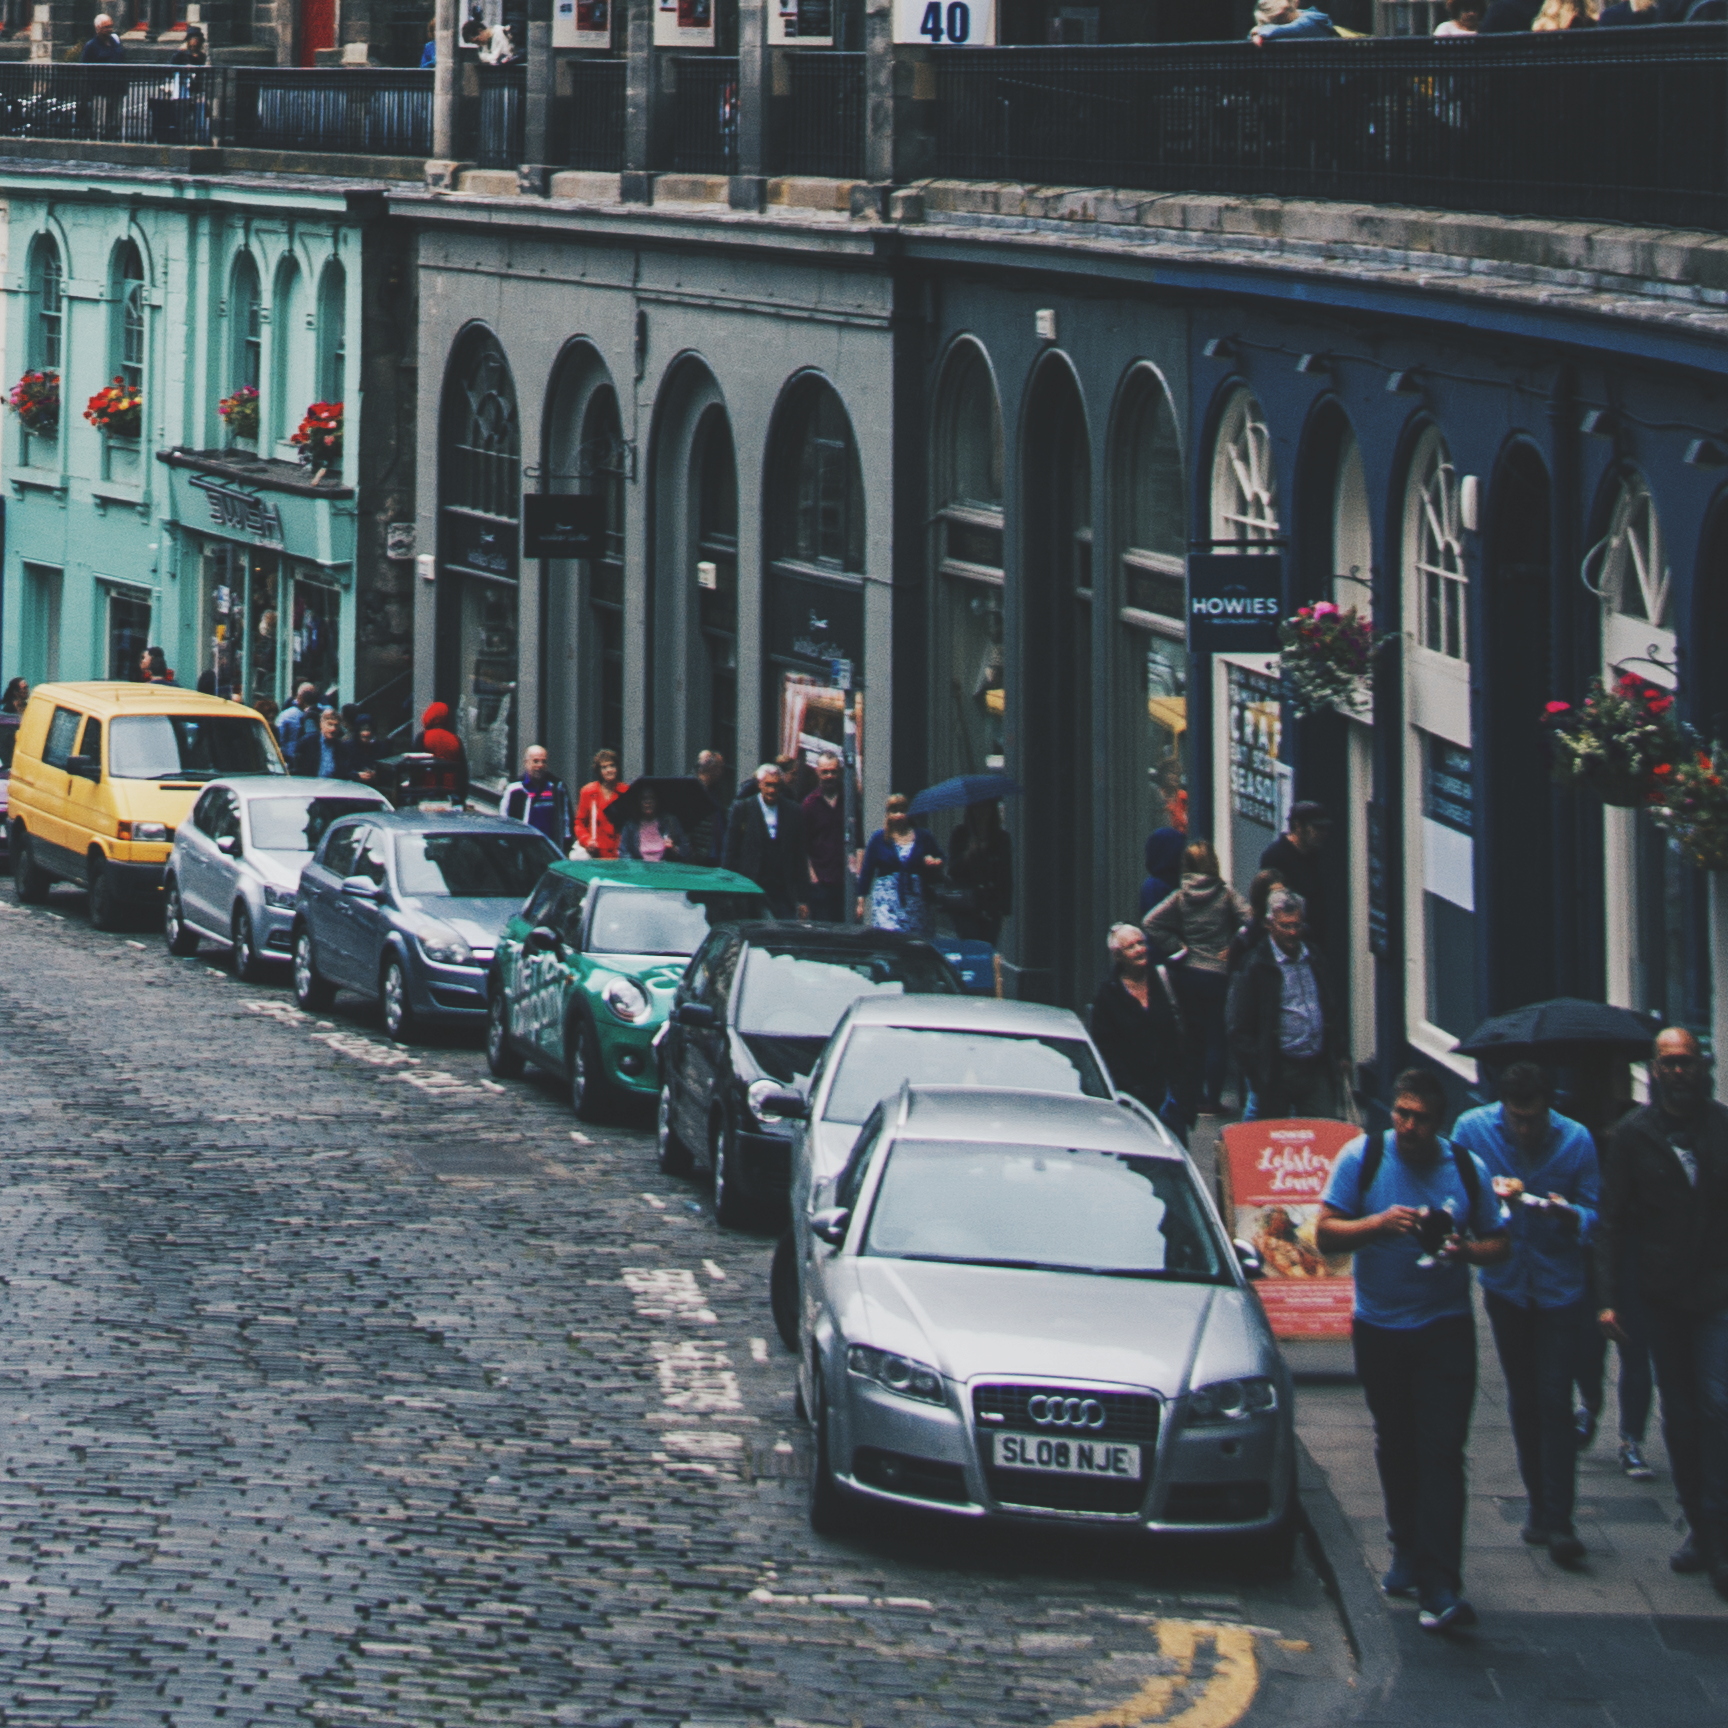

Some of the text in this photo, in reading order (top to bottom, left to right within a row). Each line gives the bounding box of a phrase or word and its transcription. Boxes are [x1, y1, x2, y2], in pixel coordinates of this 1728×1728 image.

[920, 1, 970, 43] 40
[1192, 597, 1279, 615] HOWIES
[1002, 1436, 1128, 1474] SL08 NJE
